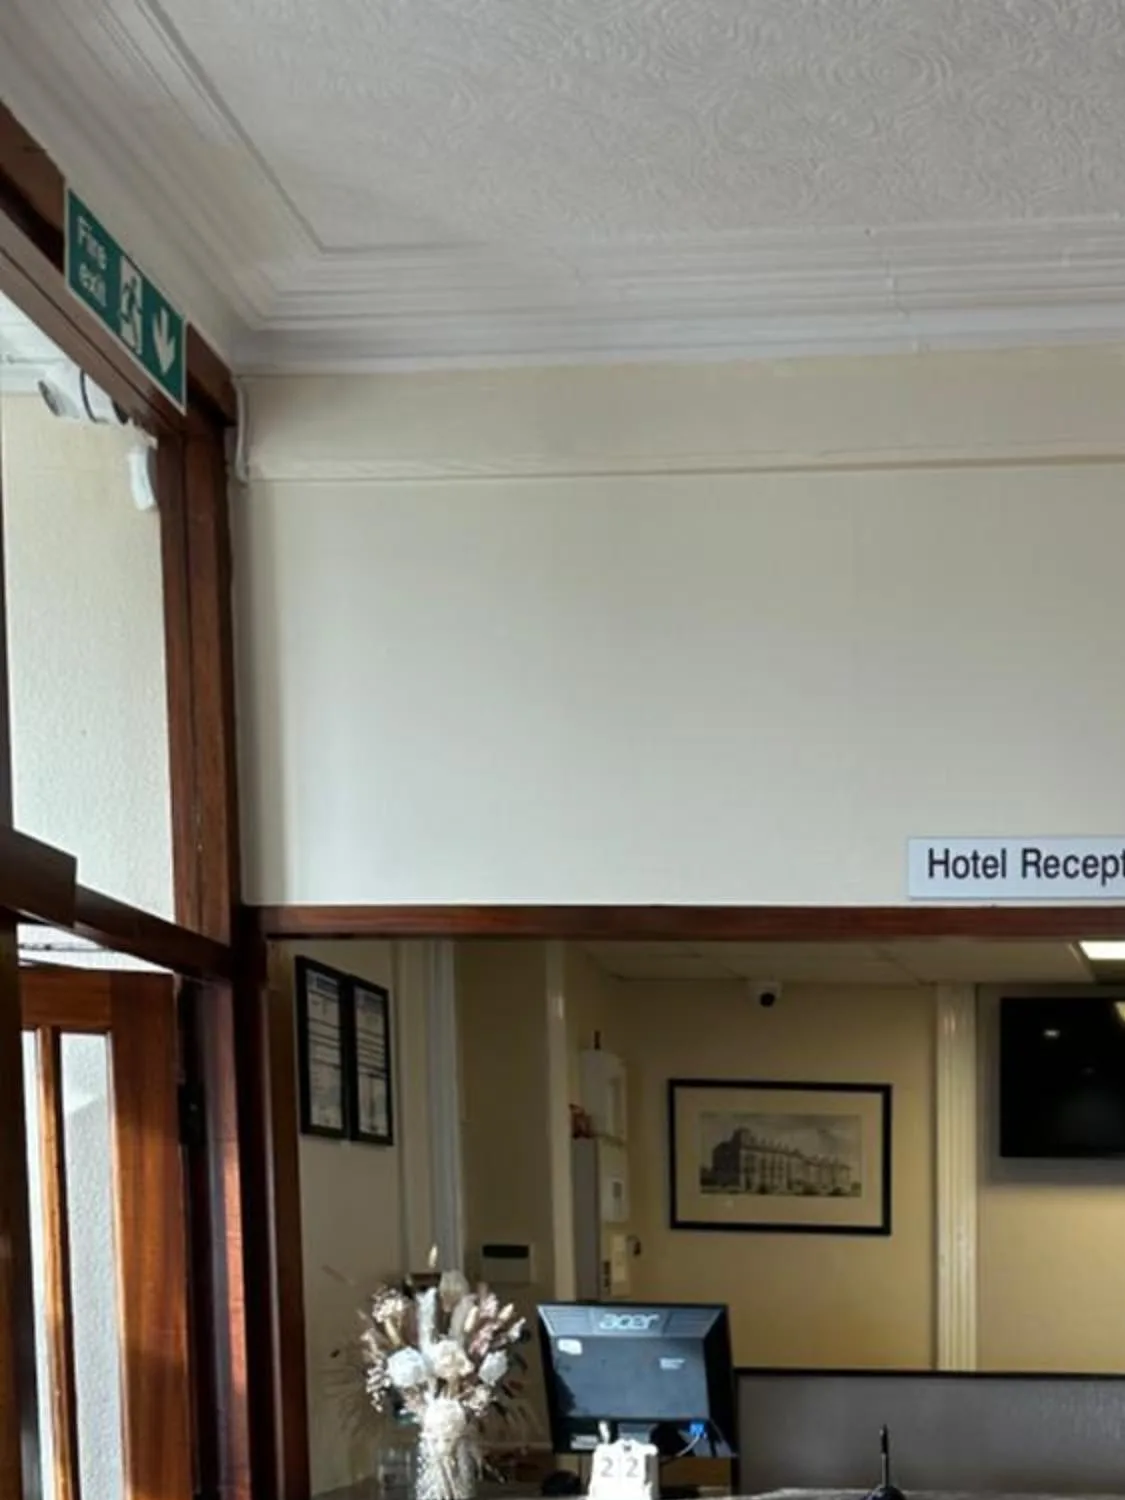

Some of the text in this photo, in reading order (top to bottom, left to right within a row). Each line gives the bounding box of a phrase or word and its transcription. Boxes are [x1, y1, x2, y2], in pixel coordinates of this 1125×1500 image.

[77, 215, 107, 271] Fire
[78, 262, 107, 308] exit
[927, 848, 1007, 879] Hotel
[599, 1313, 660, 1330] acer
